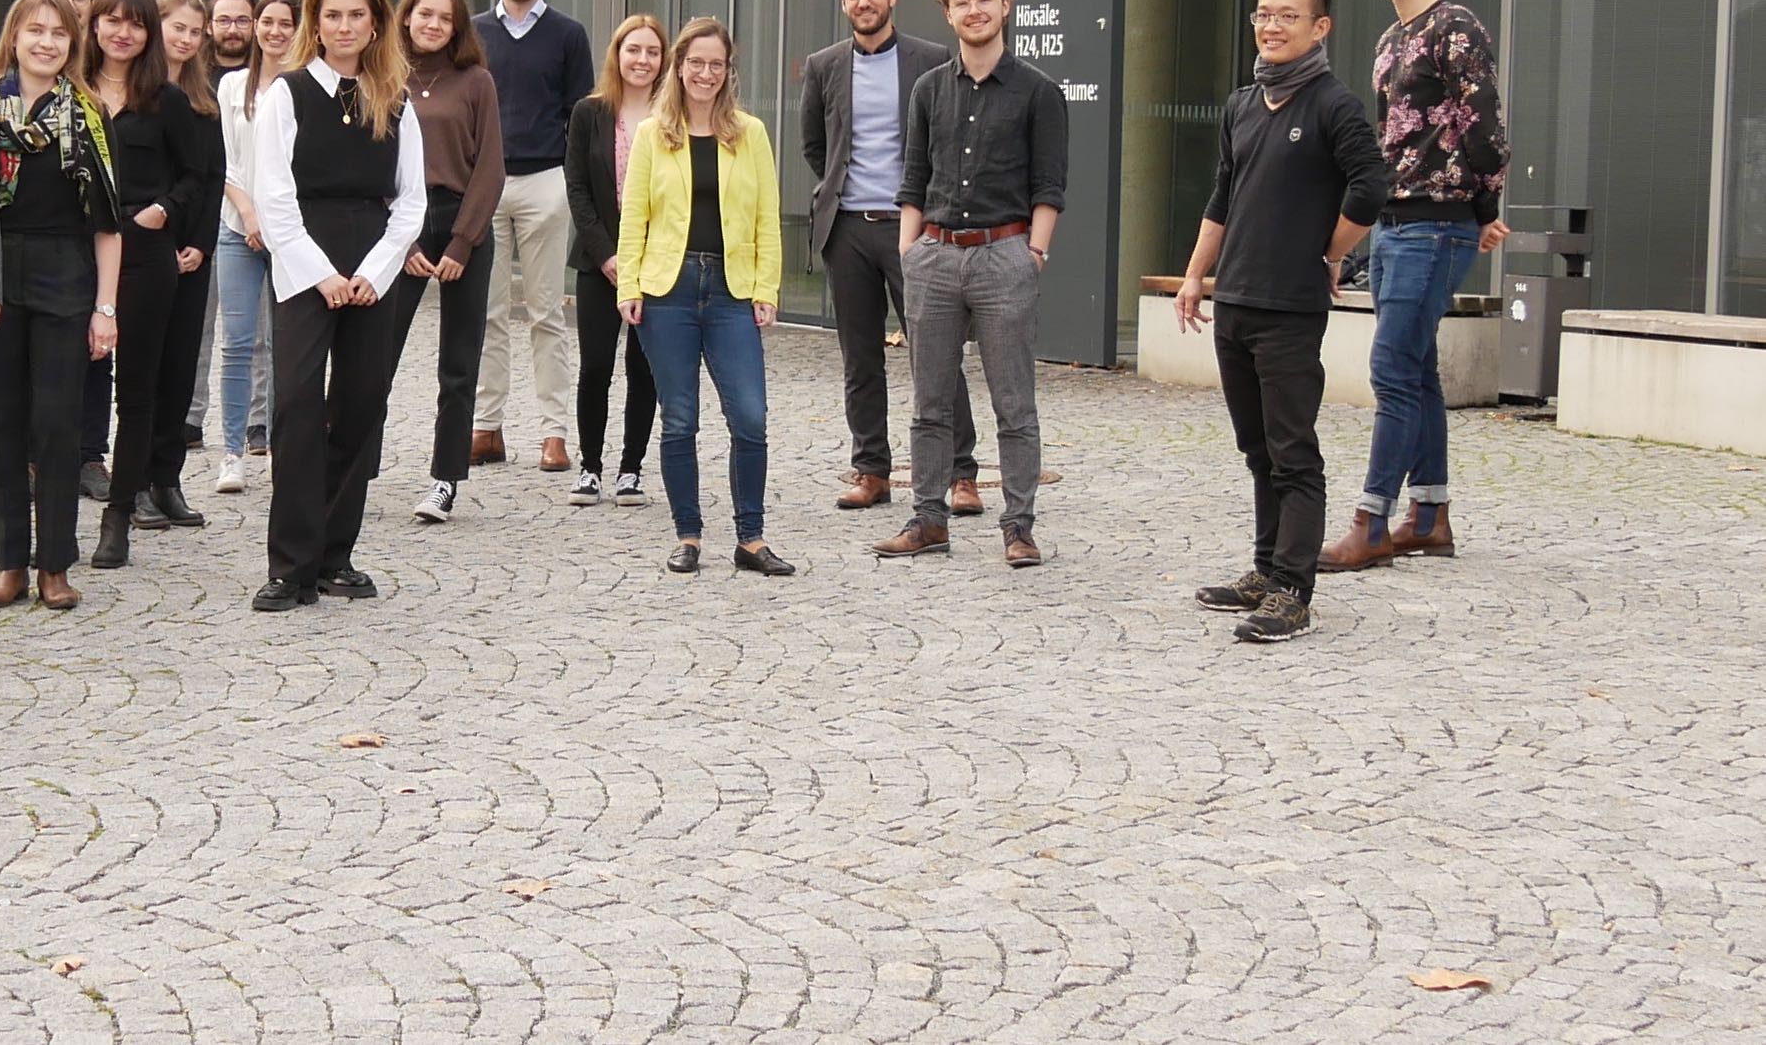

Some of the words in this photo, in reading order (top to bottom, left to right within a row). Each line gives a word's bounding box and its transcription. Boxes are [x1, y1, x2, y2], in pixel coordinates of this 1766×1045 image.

[1016, 3, 1060, 27] Hörsäle:
[1015, 34, 1040, 60] H24,
[1041, 34, 1064, 56] H25
